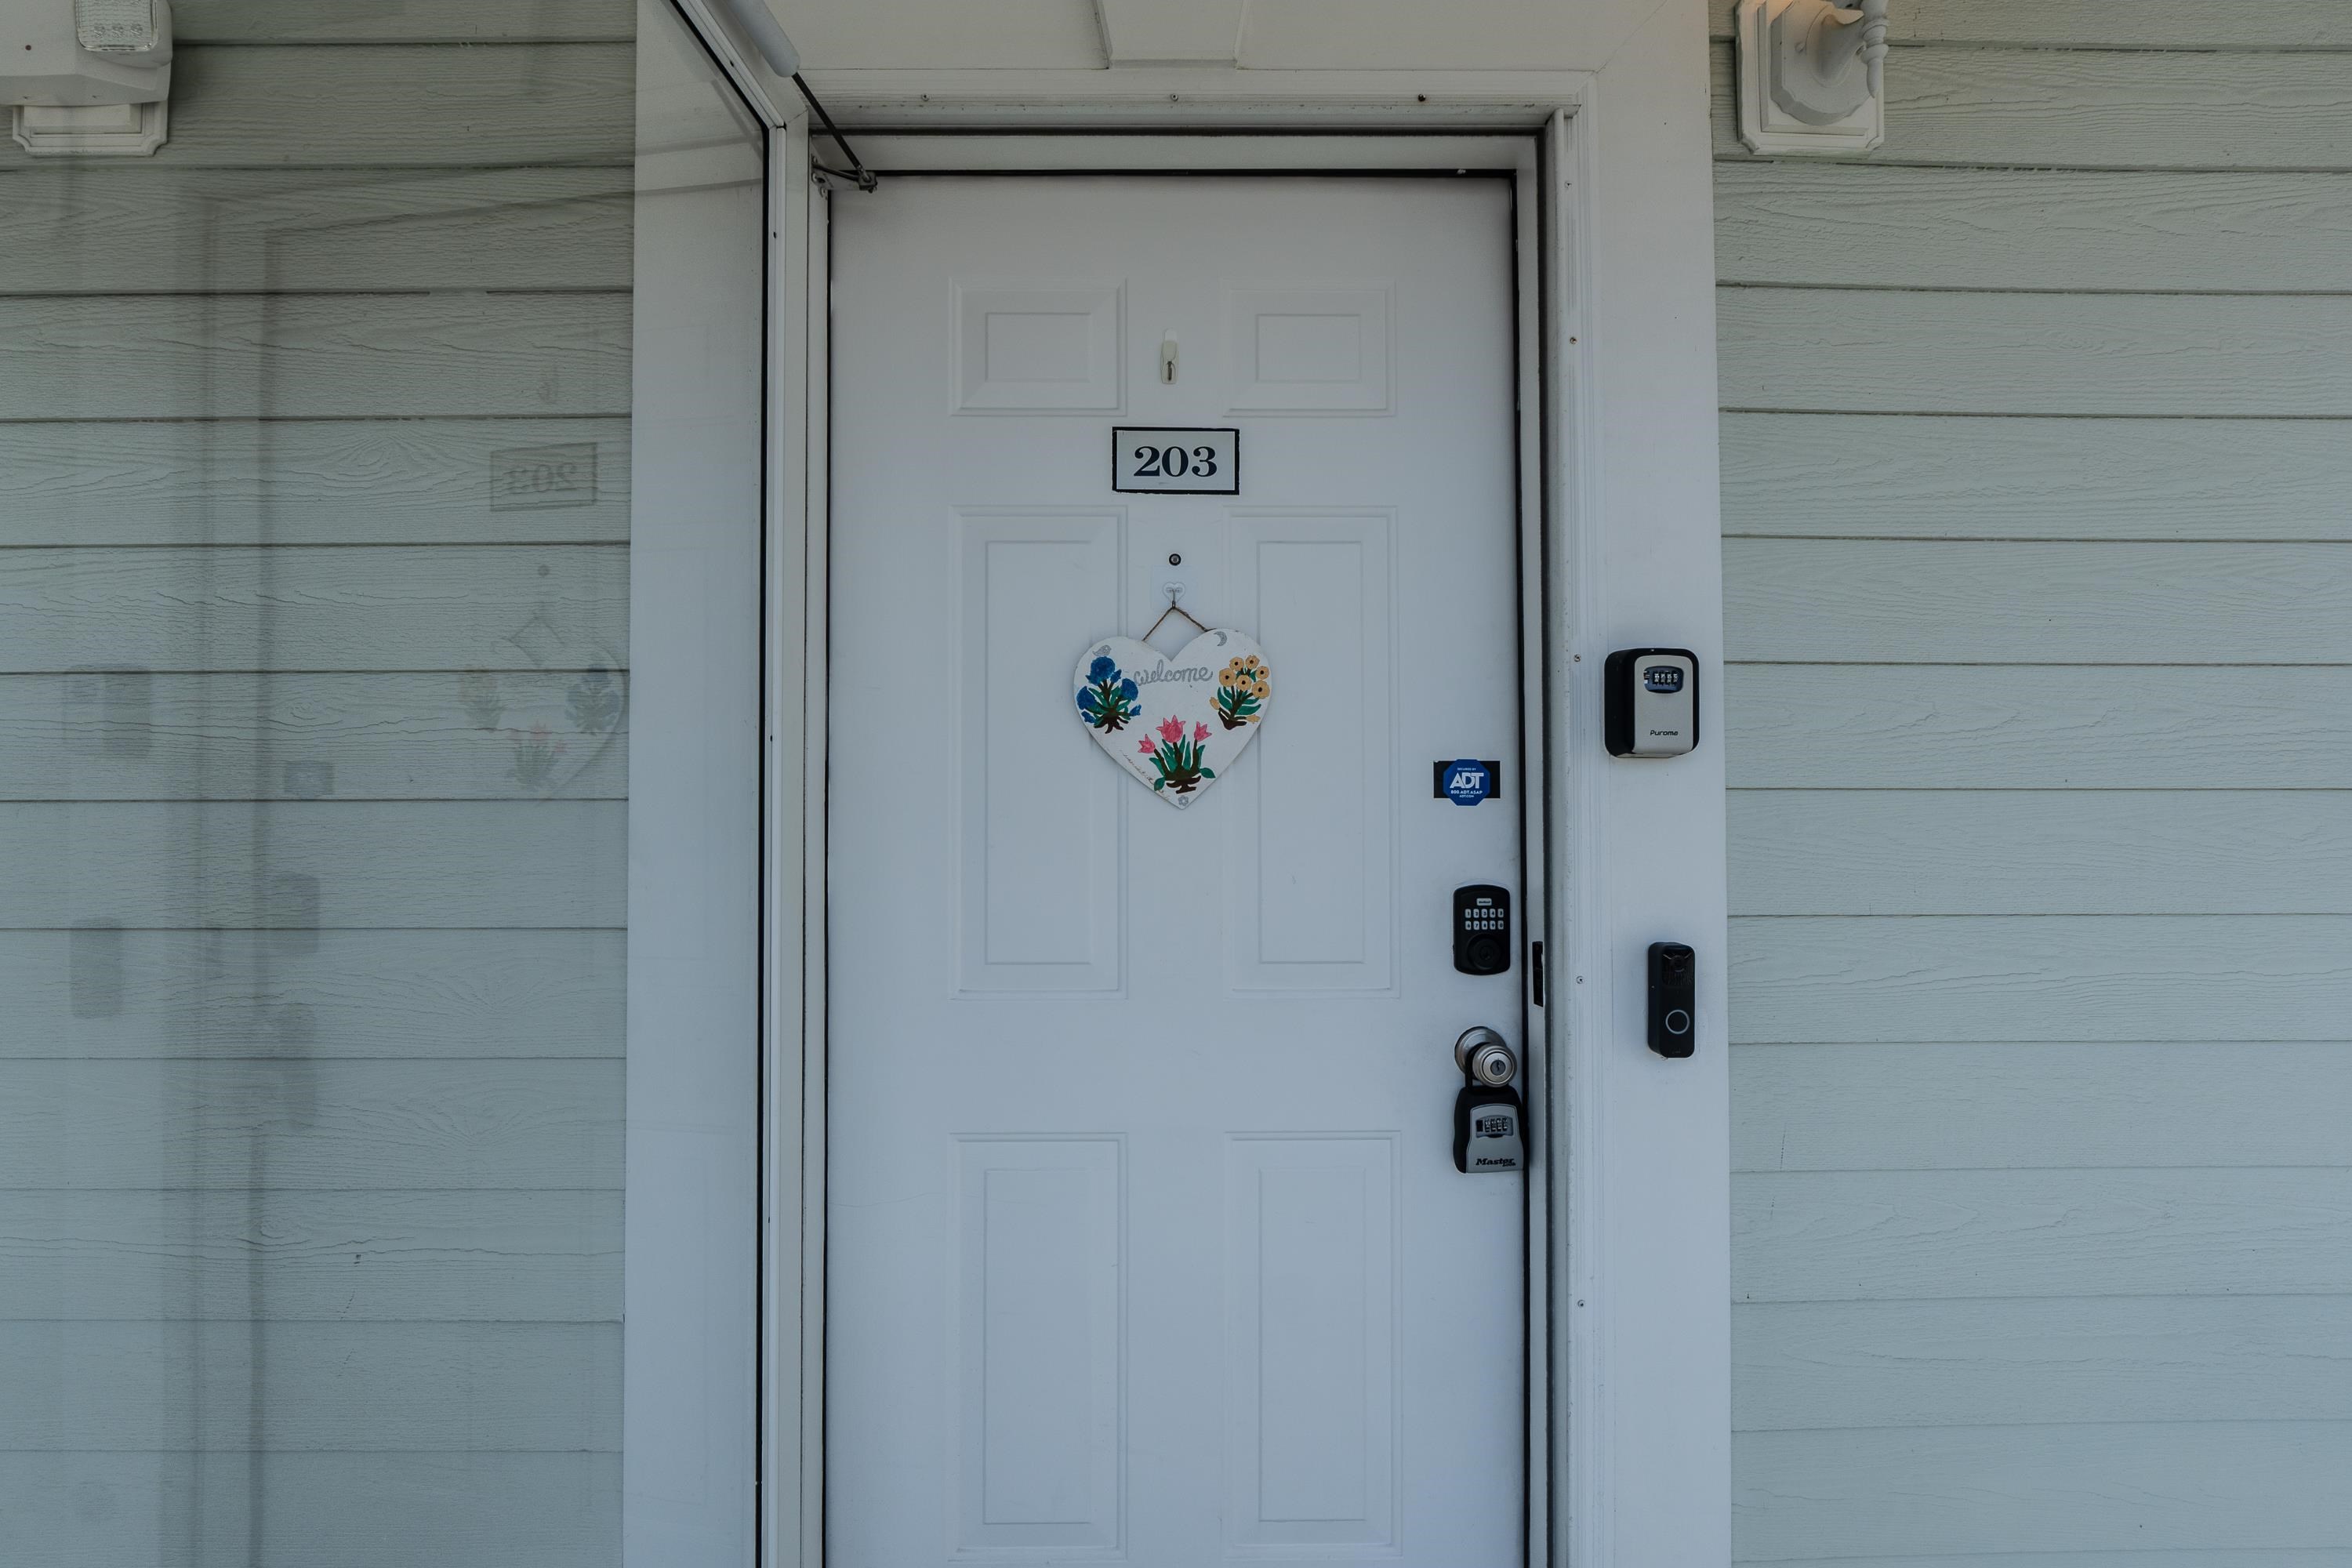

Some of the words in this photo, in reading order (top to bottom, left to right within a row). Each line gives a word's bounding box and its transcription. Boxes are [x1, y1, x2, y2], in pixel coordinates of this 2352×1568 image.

[1134, 446, 1218, 477] 203
[1134, 659, 1214, 686] welcome
[1450, 772, 1484, 789] ADT
